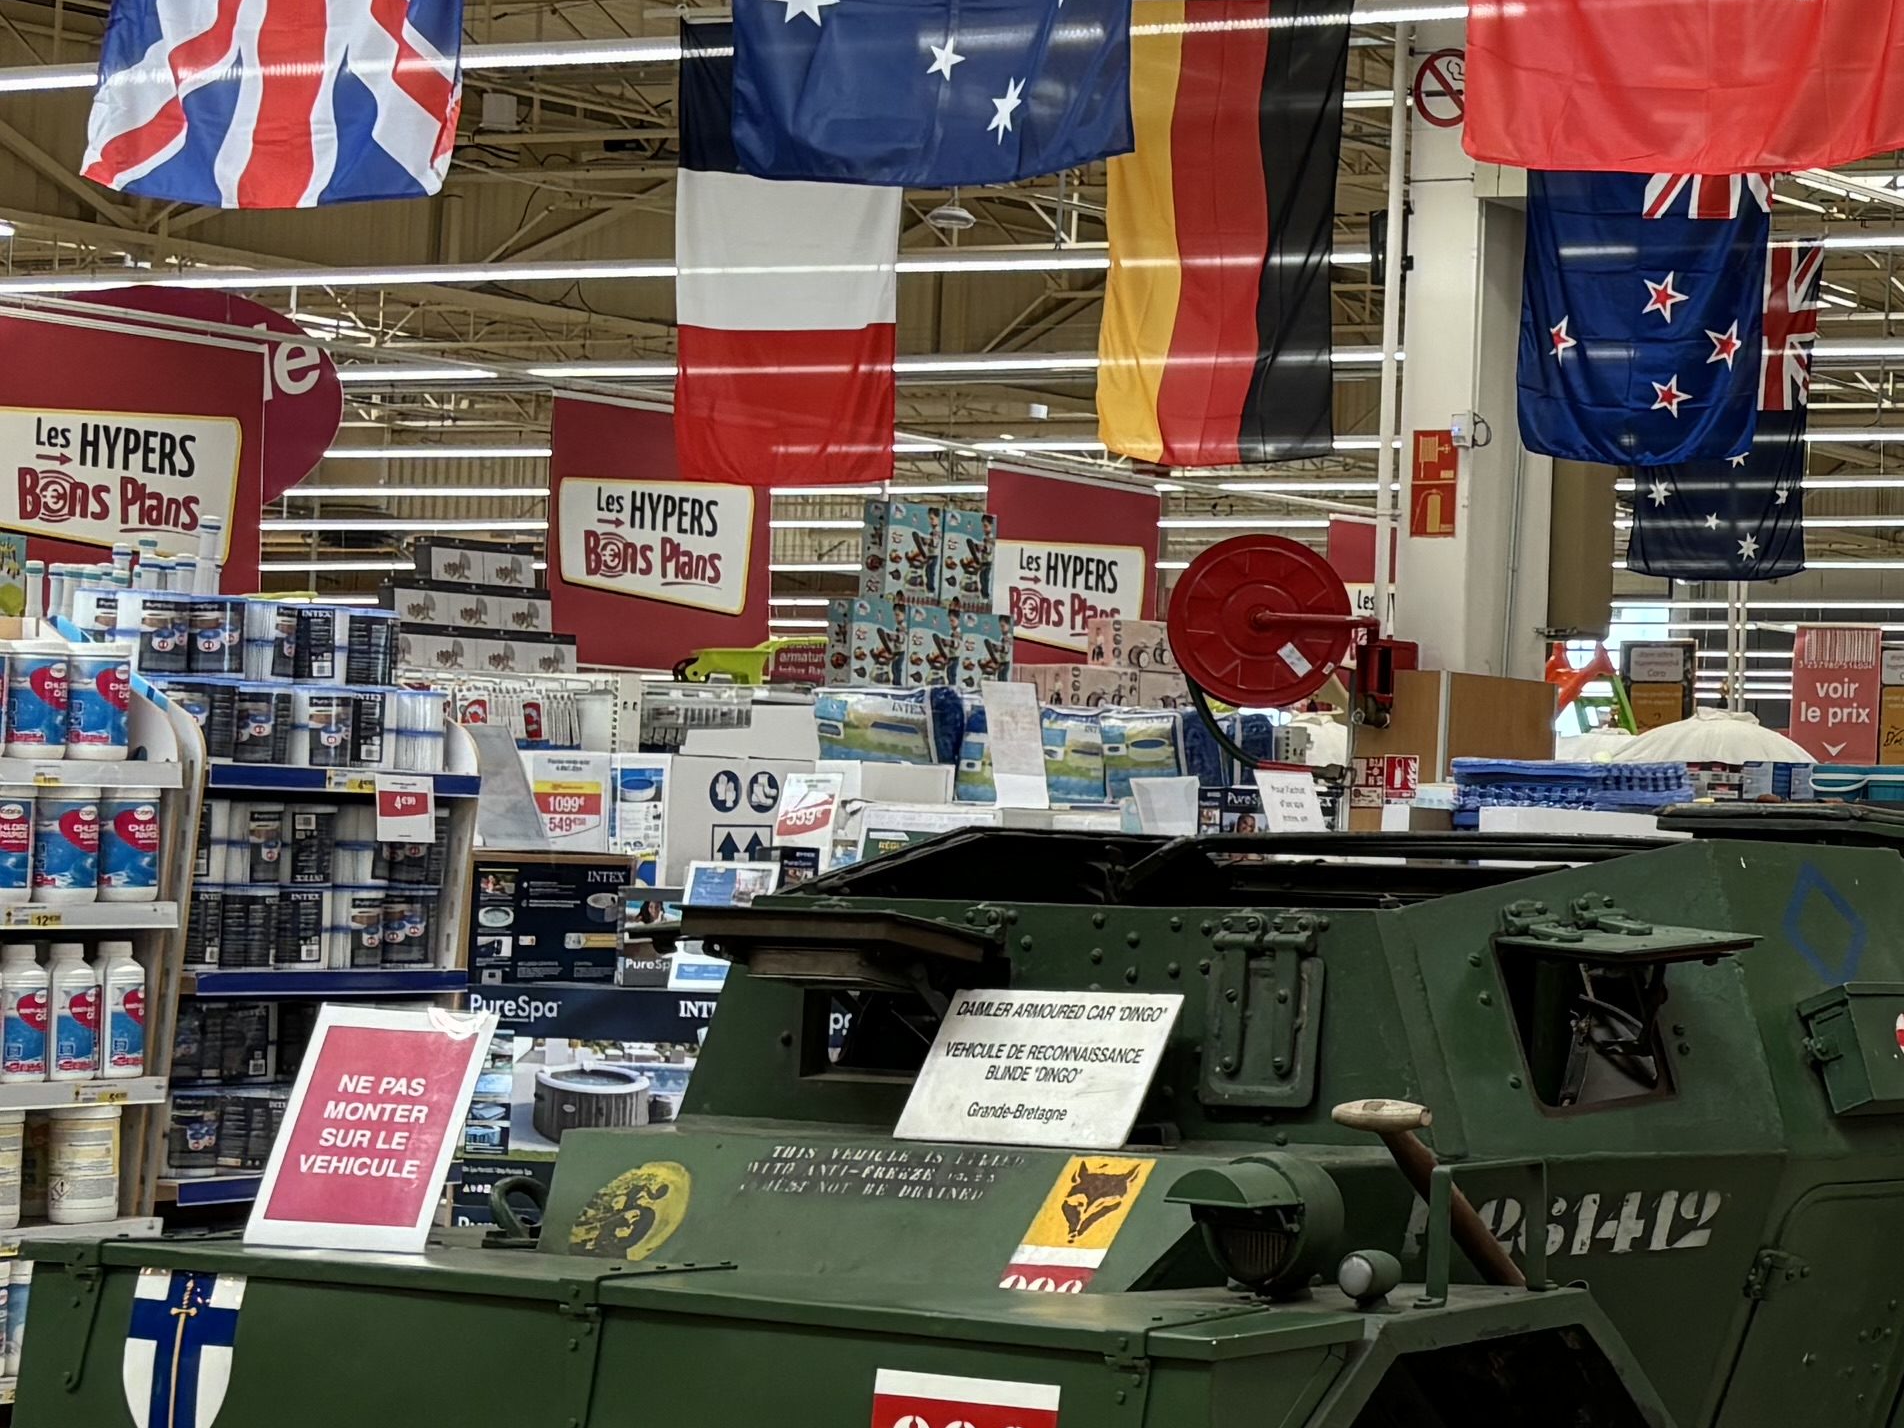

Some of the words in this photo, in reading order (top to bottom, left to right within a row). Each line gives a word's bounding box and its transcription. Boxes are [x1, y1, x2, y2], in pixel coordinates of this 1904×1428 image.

[36, 417, 71, 449] Les
[79, 423, 197, 478] HYPERS
[120, 476, 201, 531] Plans
[597, 486, 624, 514] Les
[630, 490, 719, 538] HYPERS
[660, 537, 723, 585] Plans
[1019, 547, 1042, 572] Les
[1046, 551, 1119, 594] HYPERS
[1815, 677, 1859, 699] voir
[1800, 701, 1821, 723] le
[1828, 703, 1871, 728] prix
[586, 870, 625, 884] INTEX
[470, 993, 558, 1022] PureSpa
[957, 1001, 1013, 1017] DAIMLER
[1012, 1003, 1086, 1020] ARMOURED
[1086, 1005, 1117, 1021] CAR
[945, 1041, 1005, 1060] VEHICULE
[1006, 1044, 1026, 1060] DE
[1026, 1045, 1145, 1065] RECONNAISSANCE
[984, 1064, 1034, 1082] BLINDE
[337, 1074, 375, 1095] NE
[378, 1076, 426, 1097] PAS
[323, 1100, 429, 1124] MONTER
[967, 1102, 1068, 1124] Grande-Bretagne
[318, 1127, 372, 1149] SUR
[375, 1130, 410, 1151] LE
[299, 1154, 421, 1179] VEHICULE
[772, 1145, 819, 1159] THIS
[831, 1148, 910, 1163] VEHICLE
[924, 1150, 945, 1164] IS
[862, 1182, 890, 1197] BE
